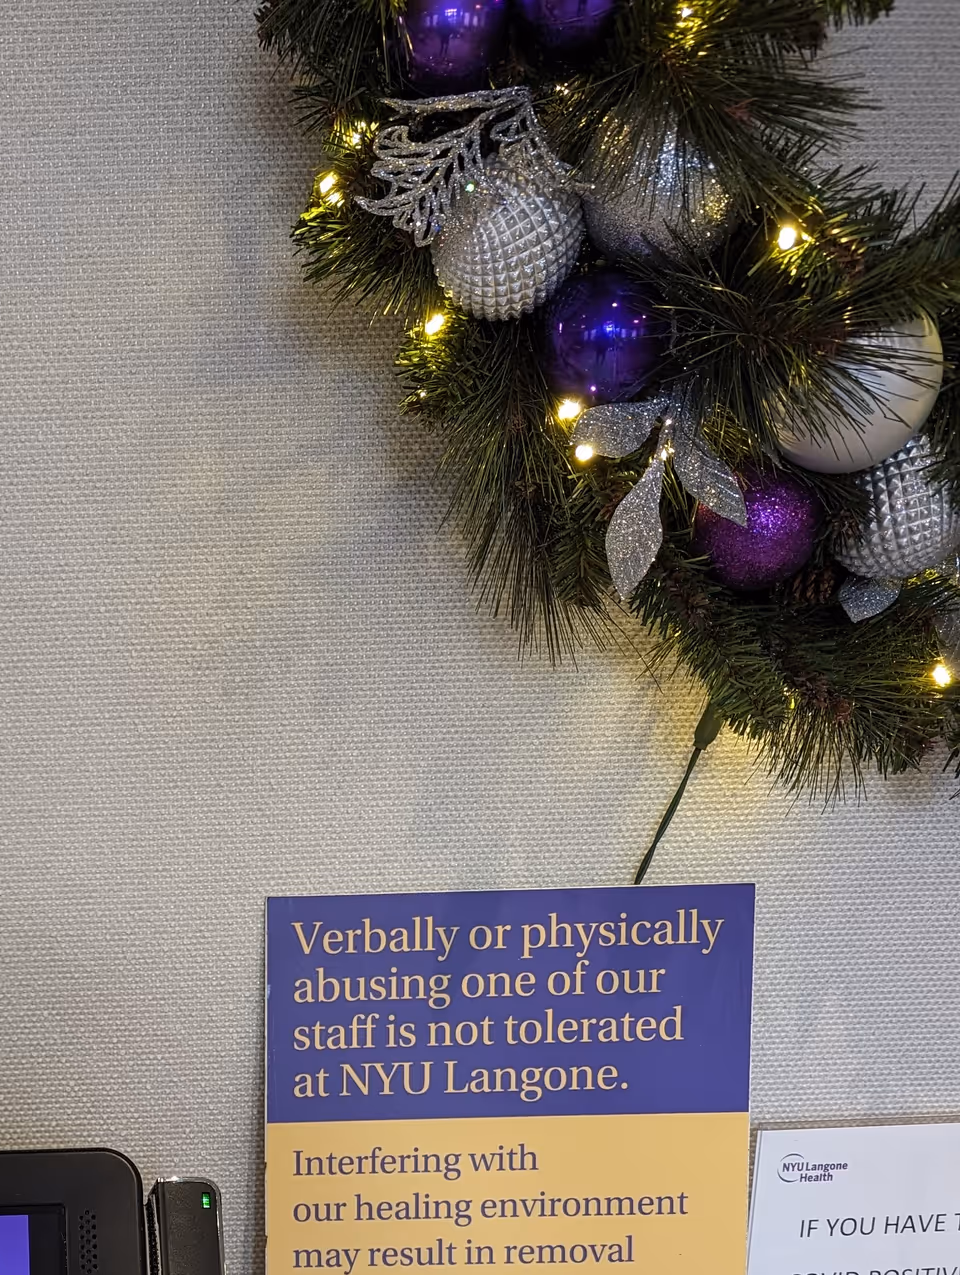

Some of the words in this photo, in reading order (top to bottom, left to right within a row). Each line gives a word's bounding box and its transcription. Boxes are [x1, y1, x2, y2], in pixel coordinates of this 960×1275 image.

[291, 916, 460, 961] Verbally
[469, 922, 510, 951] or
[521, 909, 724, 959] physically
[293, 966, 451, 1009] abusing
[461, 971, 536, 998] one
[547, 960, 590, 995] of
[596, 966, 665, 995] our
[293, 1012, 379, 1051] staff
[386, 1014, 416, 1047] is
[427, 1014, 495, 1046] not
[504, 1005, 684, 1044] tolerated
[293, 1067, 330, 1098] at
[339, 1061, 433, 1096] NYU
[443, 1059, 629, 1102] Langone.
[292, 1146, 462, 1181] Interfering
[469, 1143, 539, 1173] with
[782, 1162, 804, 1173] NYU
[805, 1160, 848, 1173] Langone
[799, 1172, 833, 1183] Health
[293, 1200, 347, 1223] our
[354, 1192, 473, 1227] healing
[480, 1191, 689, 1219] environment
[799, 1219, 819, 1238] IF
[826, 1216, 876, 1238] YOU
[884, 1213, 947, 1235] HAVE
[292, 1245, 361, 1275] may
[367, 1239, 457, 1267] result
[465, 1237, 496, 1265] in
[504, 1235, 635, 1265] removal
